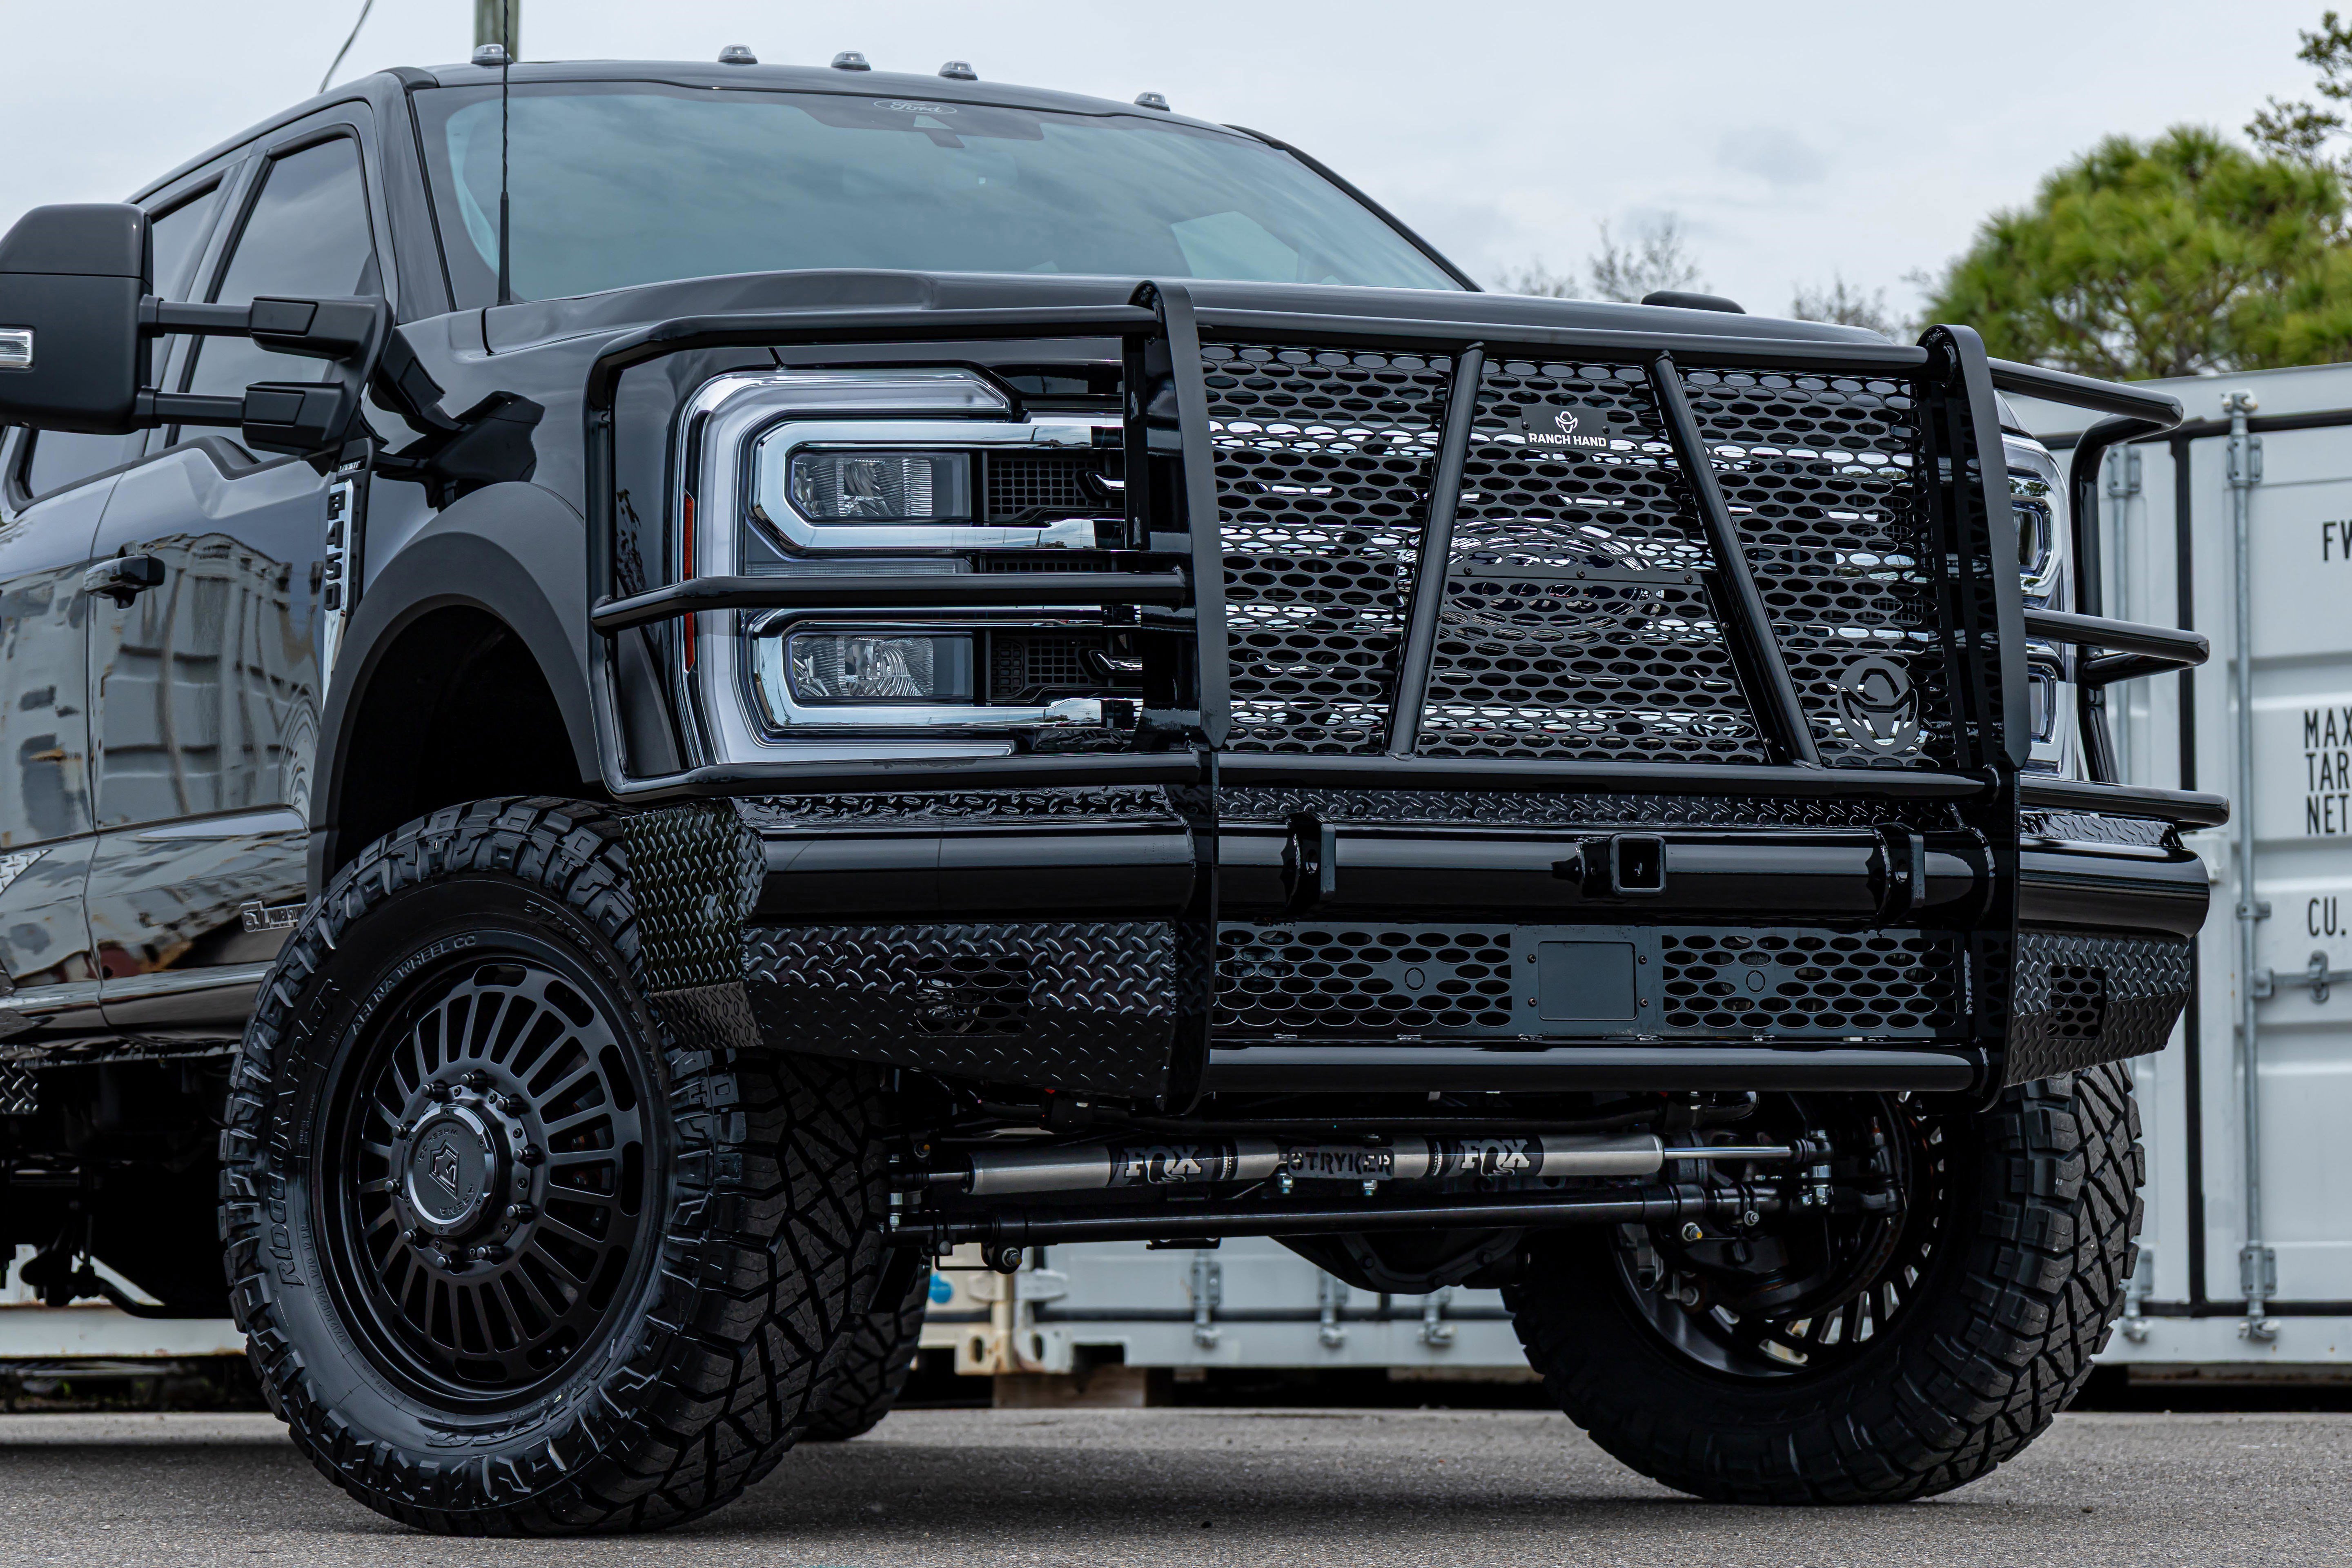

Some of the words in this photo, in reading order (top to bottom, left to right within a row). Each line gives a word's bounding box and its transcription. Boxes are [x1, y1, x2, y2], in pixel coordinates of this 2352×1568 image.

[890, 101, 942, 112] Ford
[1528, 433, 1571, 445] RANCH
[1572, 435, 1607, 447] HAND
[2305, 706, 2352, 748] MAX
[2307, 794, 2350, 834] NET
[2308, 897, 2347, 936] CU.
[352, 980, 395, 1036] ARENA
[396, 941, 450, 978] WHEEL
[453, 933, 476, 949] CO
[1122, 1144, 1202, 1184] FOX
[1290, 1152, 1392, 1176] STRYKER
[1459, 1138, 1530, 1176] FOX
[439, 1184, 474, 1216] ARENA
[268, 1171, 304, 1286] RIDGE
